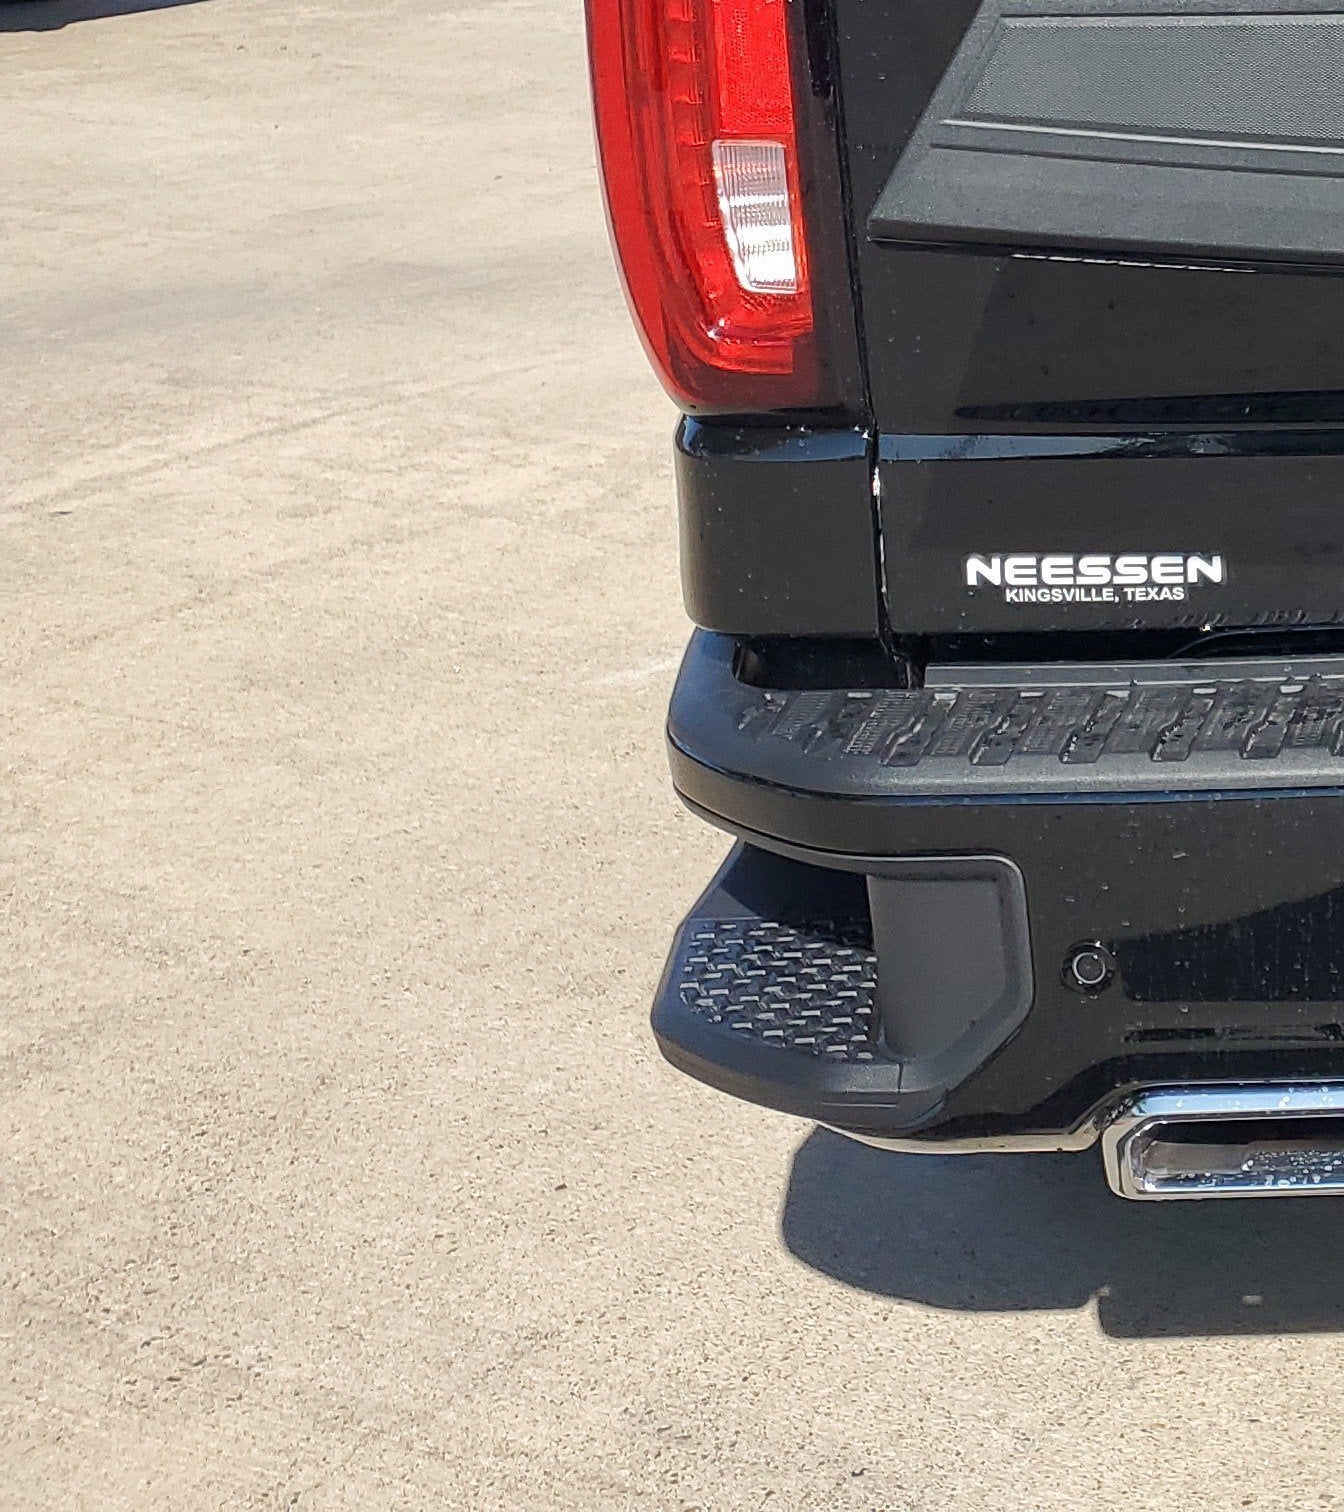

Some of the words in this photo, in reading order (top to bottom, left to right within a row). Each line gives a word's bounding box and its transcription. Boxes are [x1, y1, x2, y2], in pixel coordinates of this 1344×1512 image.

[965, 554, 1223, 586] NEESSEN
[1005, 587, 1120, 603] KINGSVILLE,
[1123, 586, 1185, 601] TEXAS
